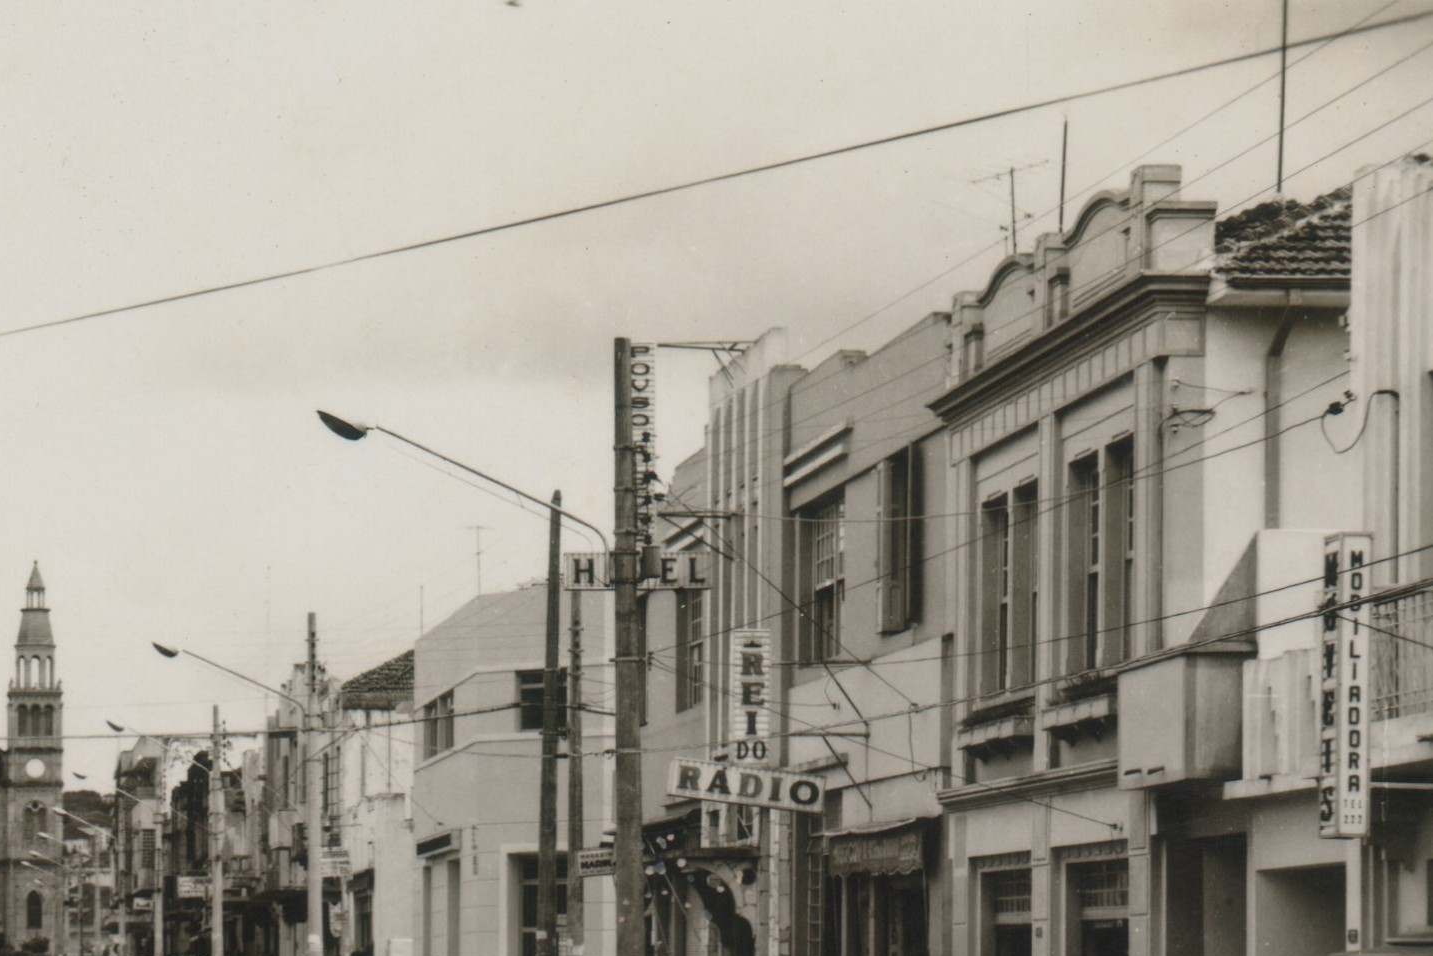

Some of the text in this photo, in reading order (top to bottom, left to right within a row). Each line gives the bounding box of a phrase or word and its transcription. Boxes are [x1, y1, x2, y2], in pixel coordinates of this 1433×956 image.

[740, 652, 766, 735] REI
[1348, 550, 1364, 793] MOBILIADORA
[736, 741, 767, 760] DO
[677, 766, 820, 806] RÁDIO
